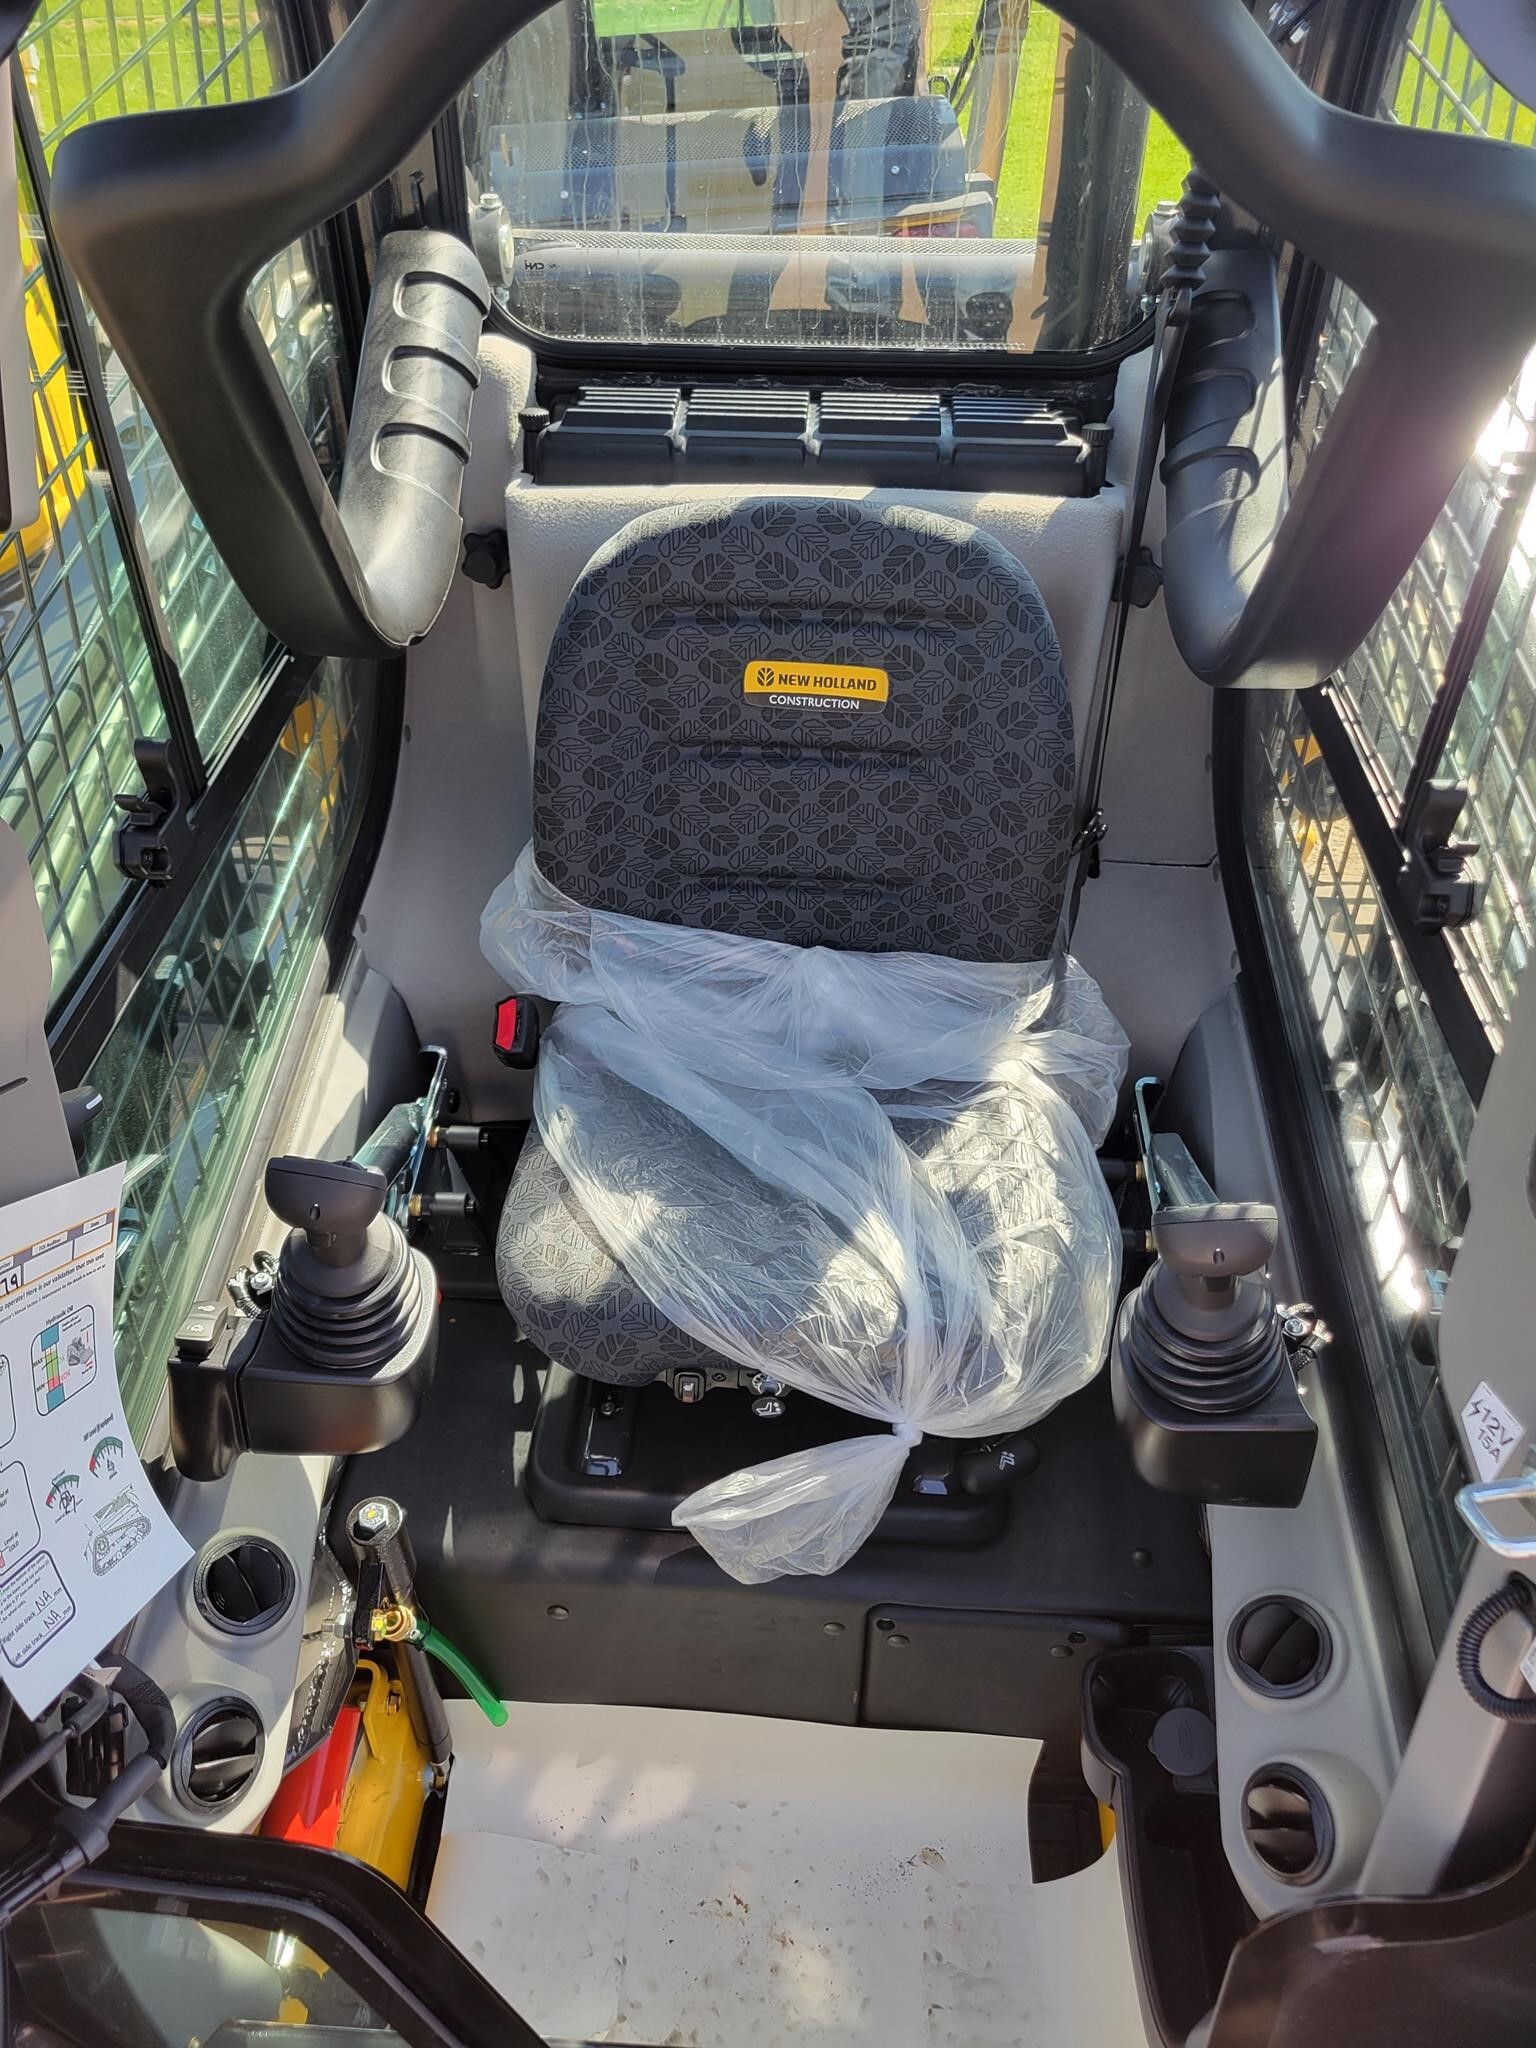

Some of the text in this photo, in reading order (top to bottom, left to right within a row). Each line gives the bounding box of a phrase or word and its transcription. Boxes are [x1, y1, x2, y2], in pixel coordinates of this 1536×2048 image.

[778, 673, 877, 691] NEW HOLLAND
[769, 694, 860, 710] CONSTRUCTION
[1482, 1406, 1514, 1446] 12V
[1478, 1427, 1500, 1463] 15A
[35, 1590, 53, 1613] NA
[43, 1609, 61, 1630] NA
